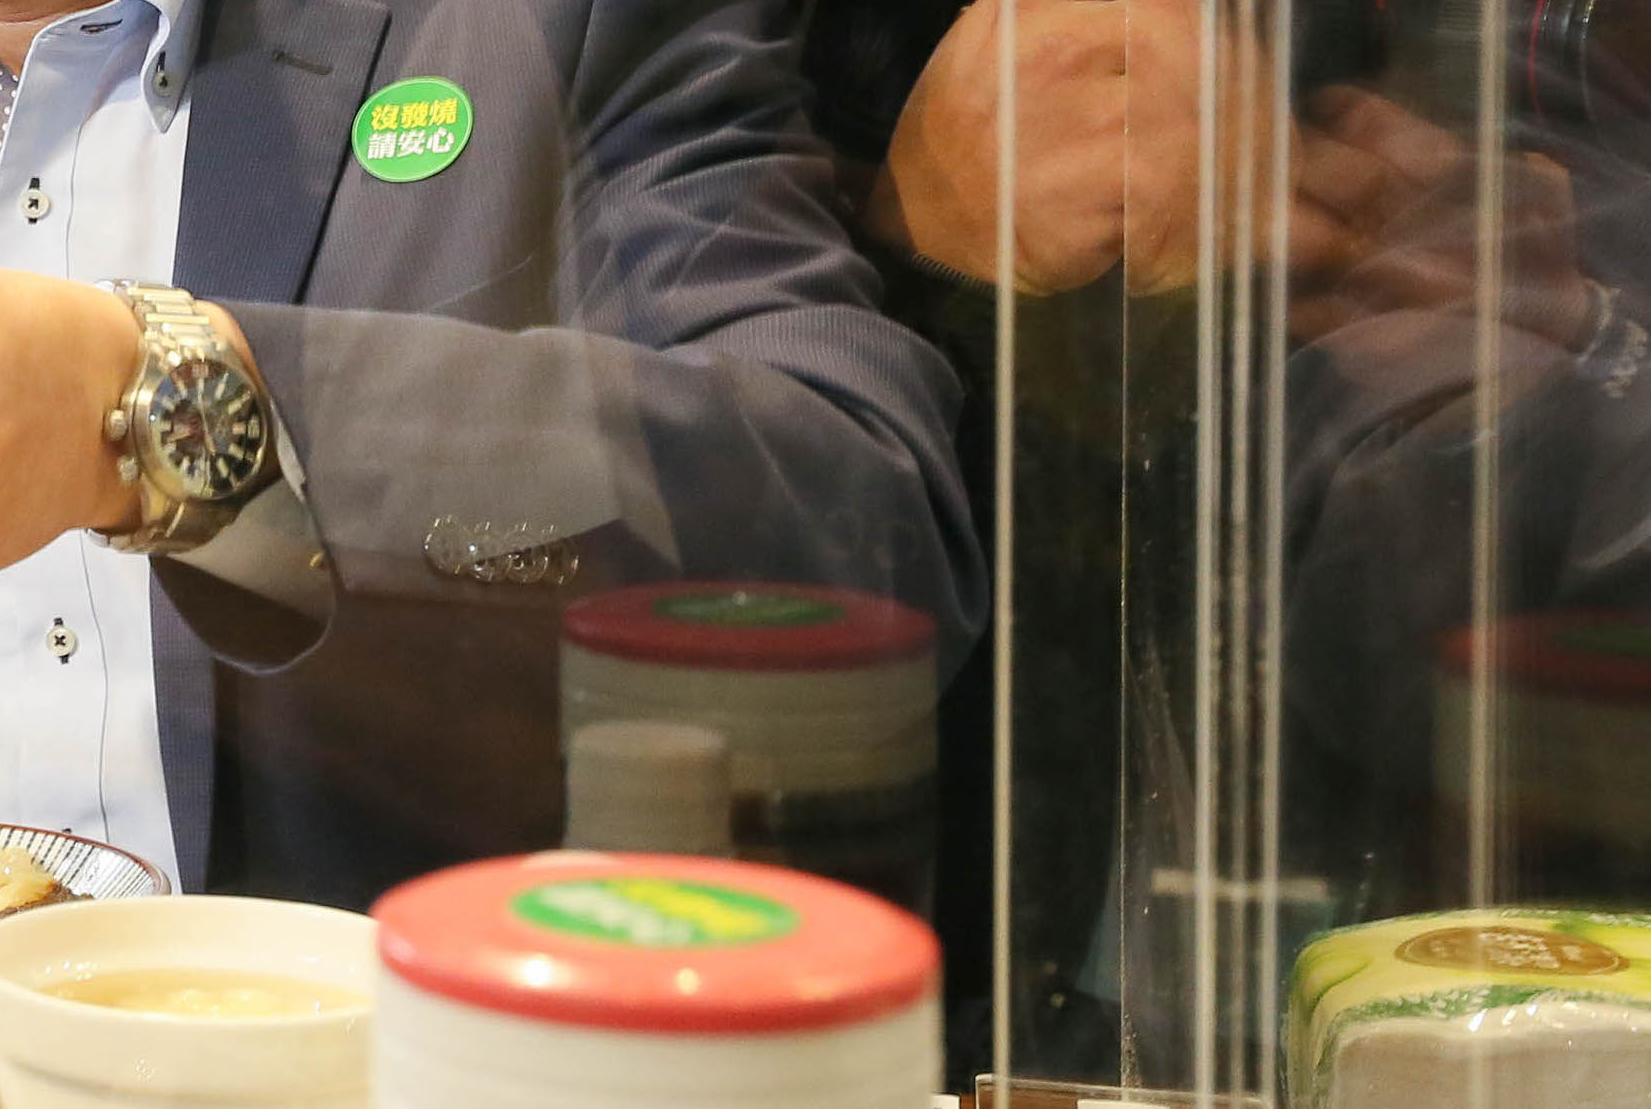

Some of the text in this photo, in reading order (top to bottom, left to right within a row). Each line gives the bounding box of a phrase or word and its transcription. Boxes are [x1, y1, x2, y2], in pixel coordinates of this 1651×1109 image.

[370, 97, 458, 131] 沒發燒
[367, 127, 455, 160] 請安心
